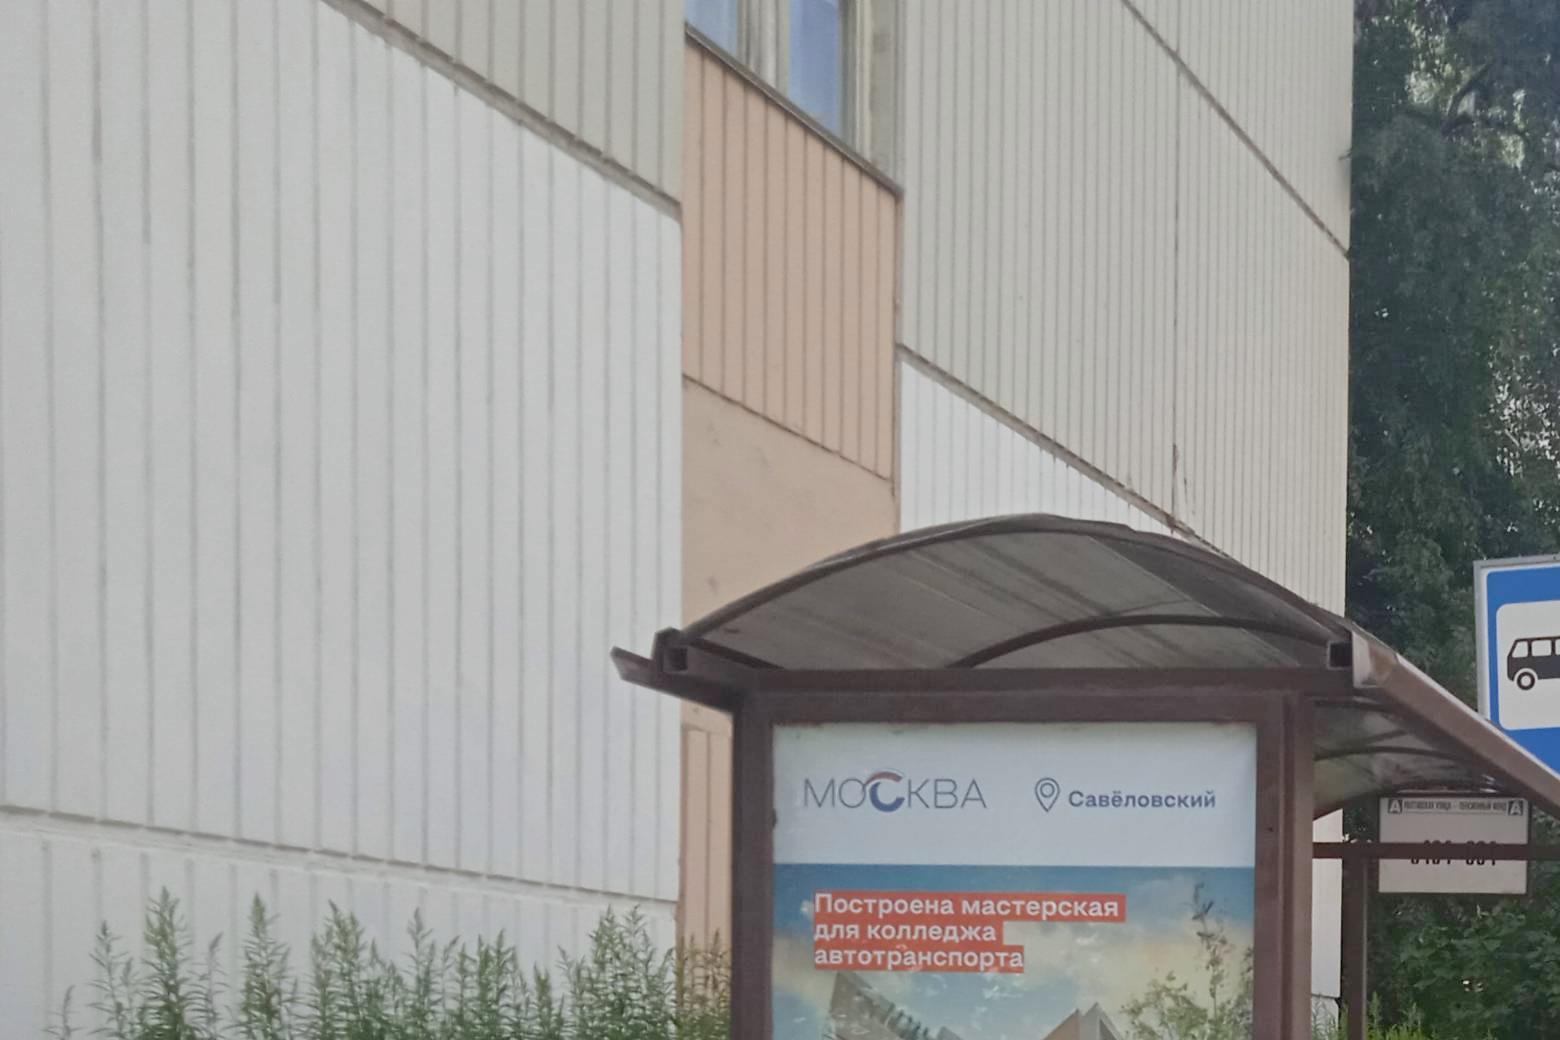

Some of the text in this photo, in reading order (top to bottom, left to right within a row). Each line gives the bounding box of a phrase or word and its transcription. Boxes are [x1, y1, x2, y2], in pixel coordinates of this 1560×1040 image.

[804, 771, 987, 812] МОСКВА
[1068, 790, 1216, 808] Савёловский
[815, 893, 1119, 920] Построена мастерская
[814, 924, 996, 942] для колледжа
[815, 949, 1024, 970] автотранспорта
